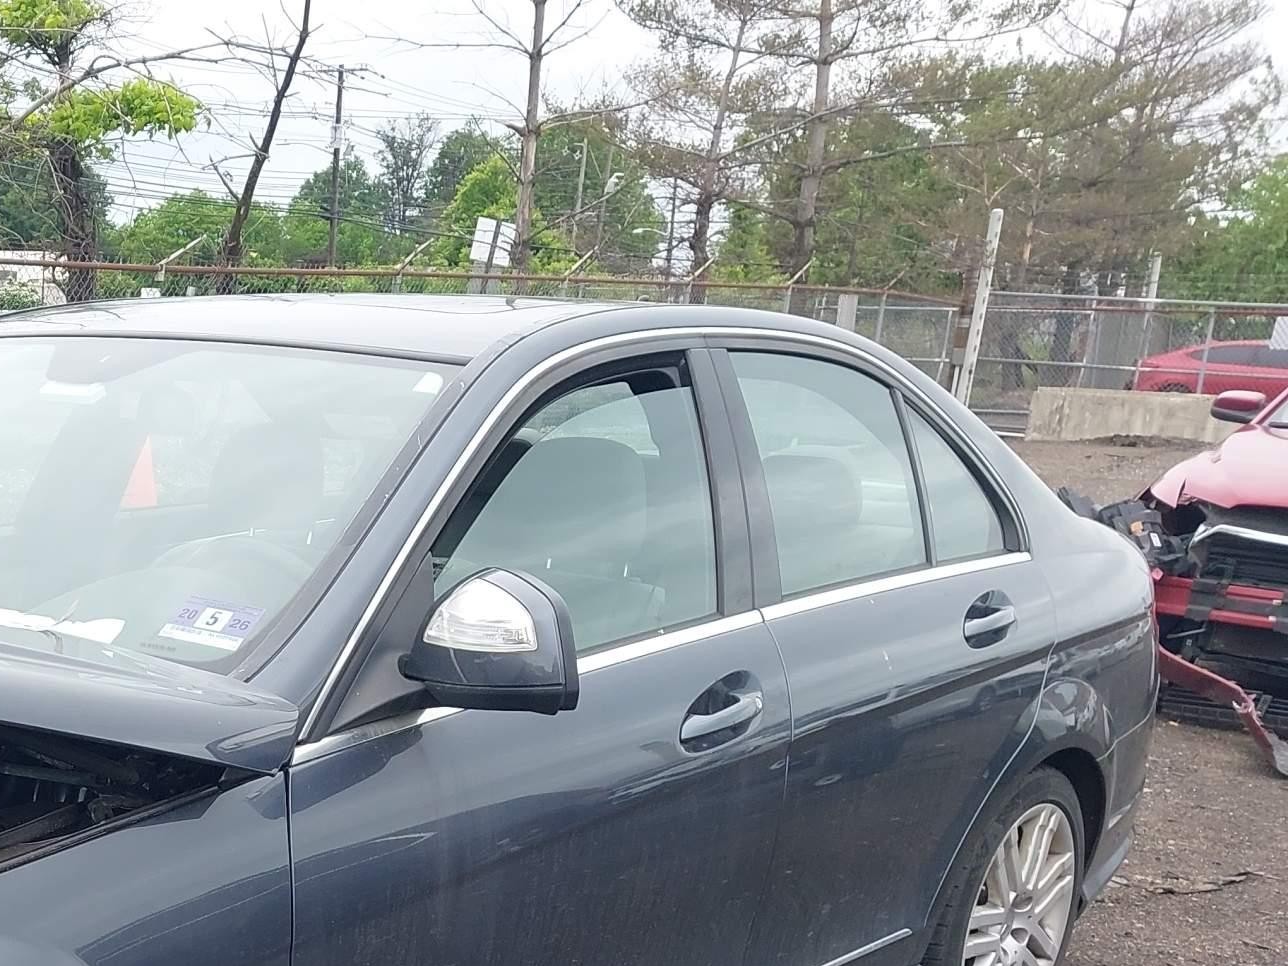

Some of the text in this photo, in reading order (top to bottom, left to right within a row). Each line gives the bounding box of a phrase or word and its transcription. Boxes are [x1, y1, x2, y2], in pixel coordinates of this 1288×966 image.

[178, 608, 251, 631] 20 5 26
